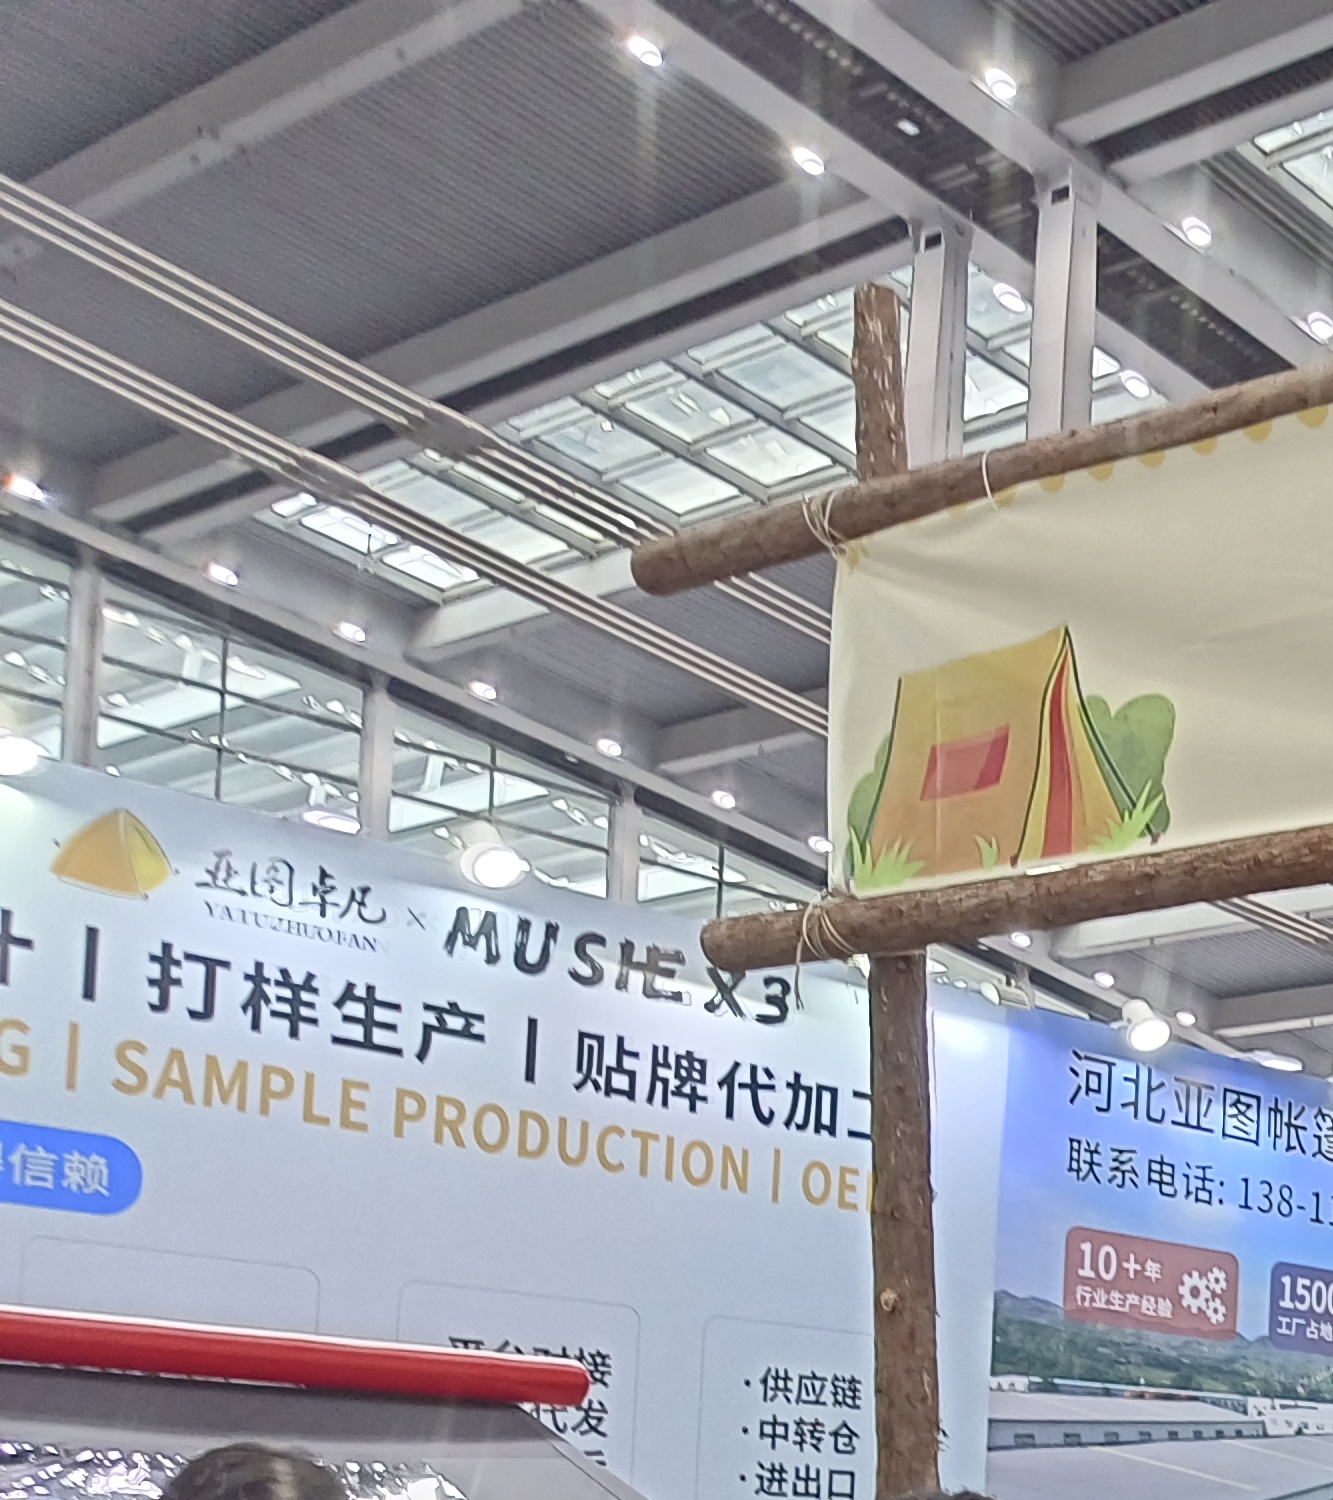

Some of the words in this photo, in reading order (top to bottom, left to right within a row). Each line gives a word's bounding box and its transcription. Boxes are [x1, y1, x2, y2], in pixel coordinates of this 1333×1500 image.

[111, 1039, 370, 1134] SAMPLE
[393, 1087, 749, 1195] PRODUCTION
[1074, 1284, 1174, 1320] 行业生产经验
